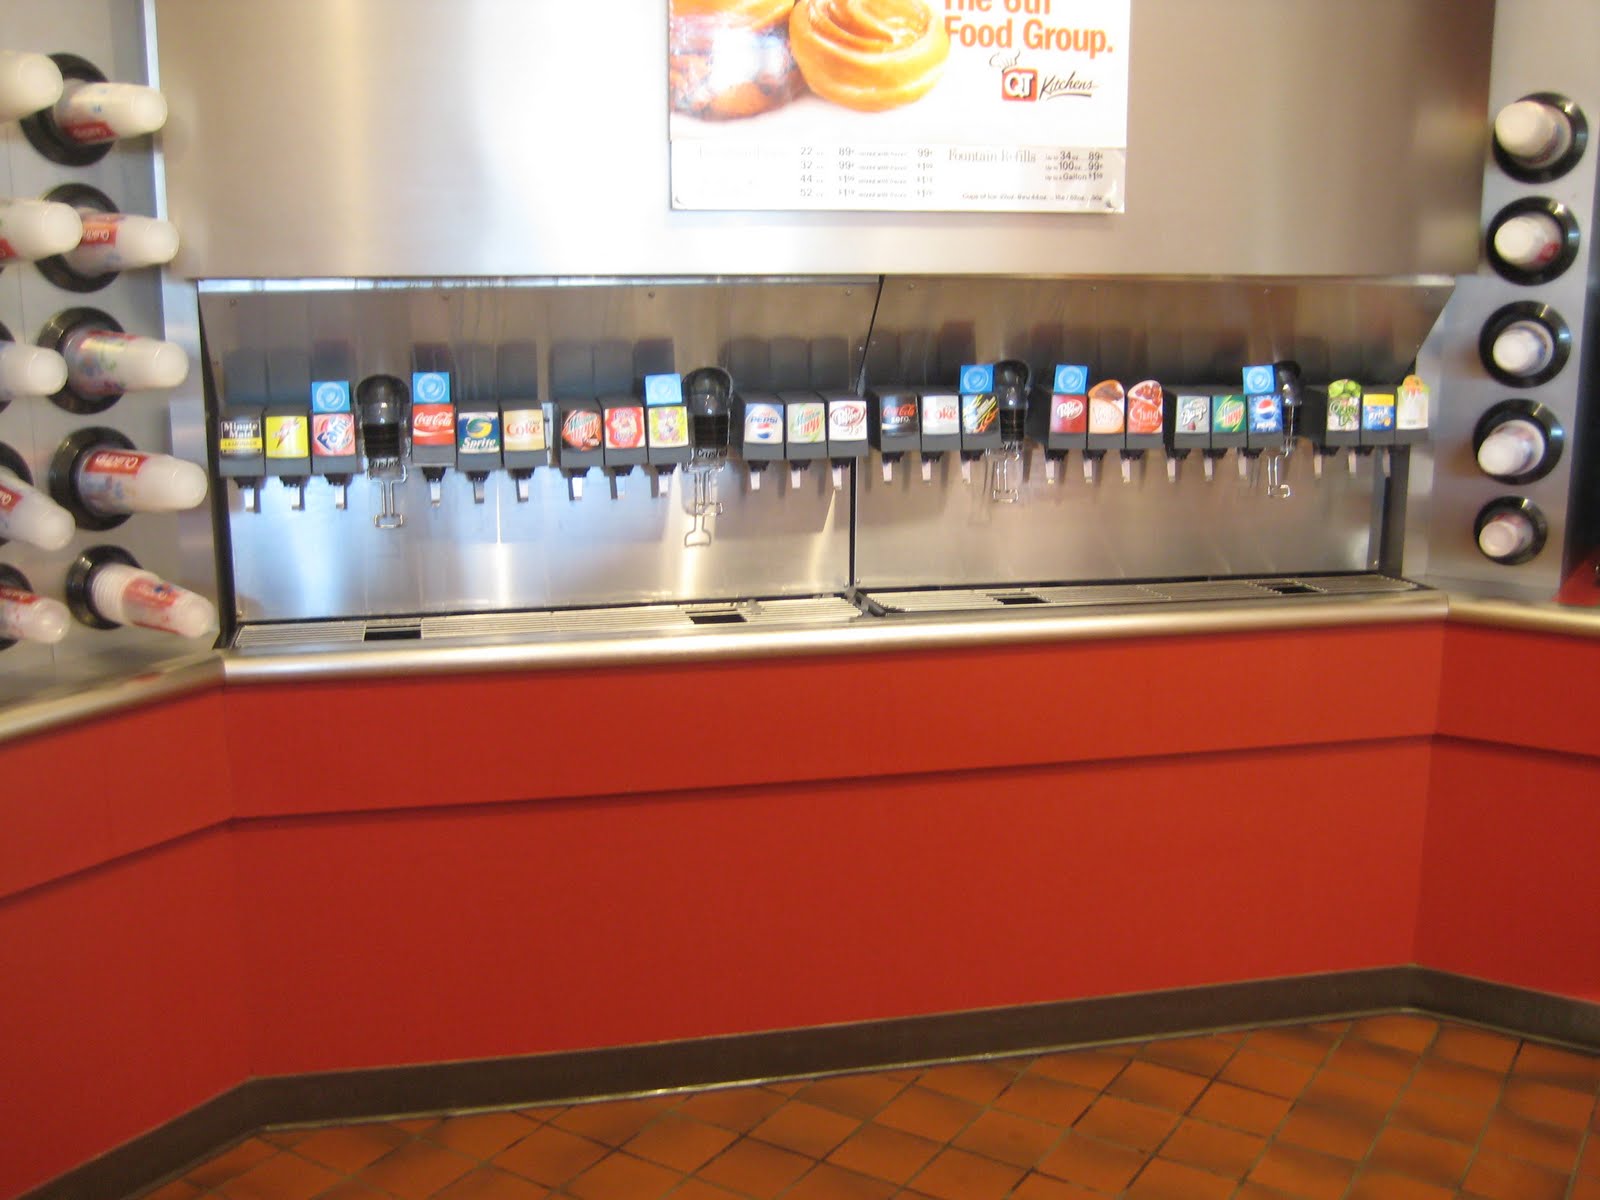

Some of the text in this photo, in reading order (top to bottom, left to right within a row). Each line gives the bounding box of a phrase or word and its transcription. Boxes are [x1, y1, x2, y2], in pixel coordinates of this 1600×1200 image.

[944, 16, 1113, 60] Food Group.
[1003, 71, 1096, 100] QT Kitchens
[800, 146, 813, 156] 22
[948, 148, 997, 162] Fountain
[1060, 151, 1071, 160] 34
[1059, 161, 1074, 171] 100
[800, 174, 813, 183] 44
[1062, 172, 1087, 180] Gallon
[223, 422, 258, 432] Minute
[229, 430, 254, 438] Maid
[462, 437, 496, 449] Sprite
